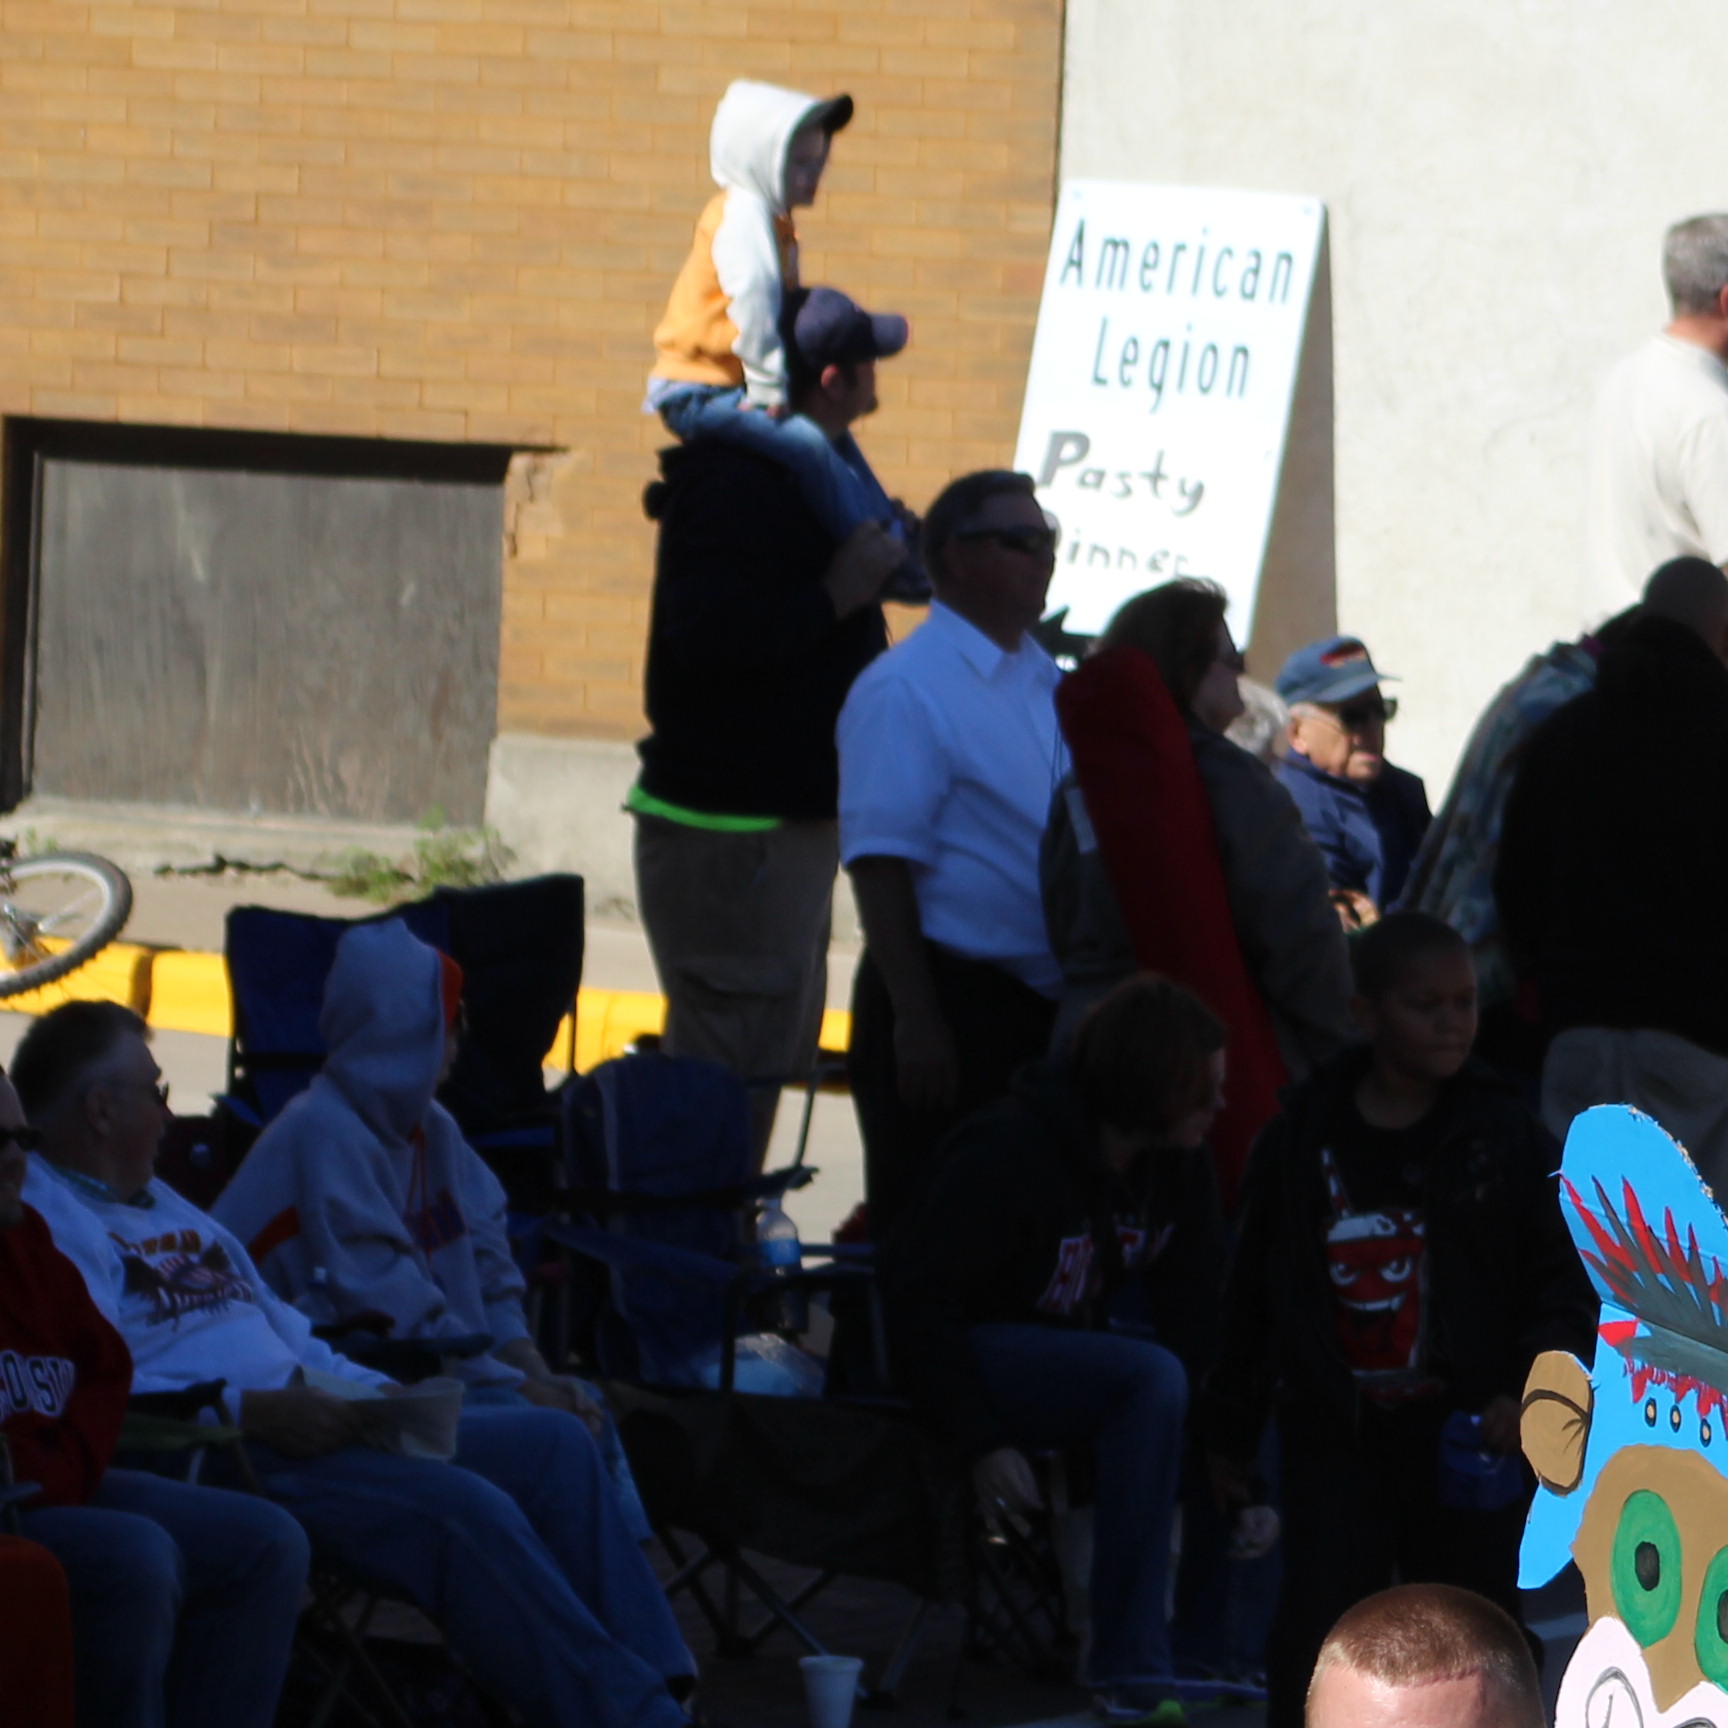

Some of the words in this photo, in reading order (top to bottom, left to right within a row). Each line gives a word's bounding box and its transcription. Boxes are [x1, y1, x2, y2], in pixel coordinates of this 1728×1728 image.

[1059, 217, 1296, 304] American
[1091, 316, 1250, 414] Legion
[1036, 431, 1205, 517] Pasty
[1040, 508, 1190, 579] inner
